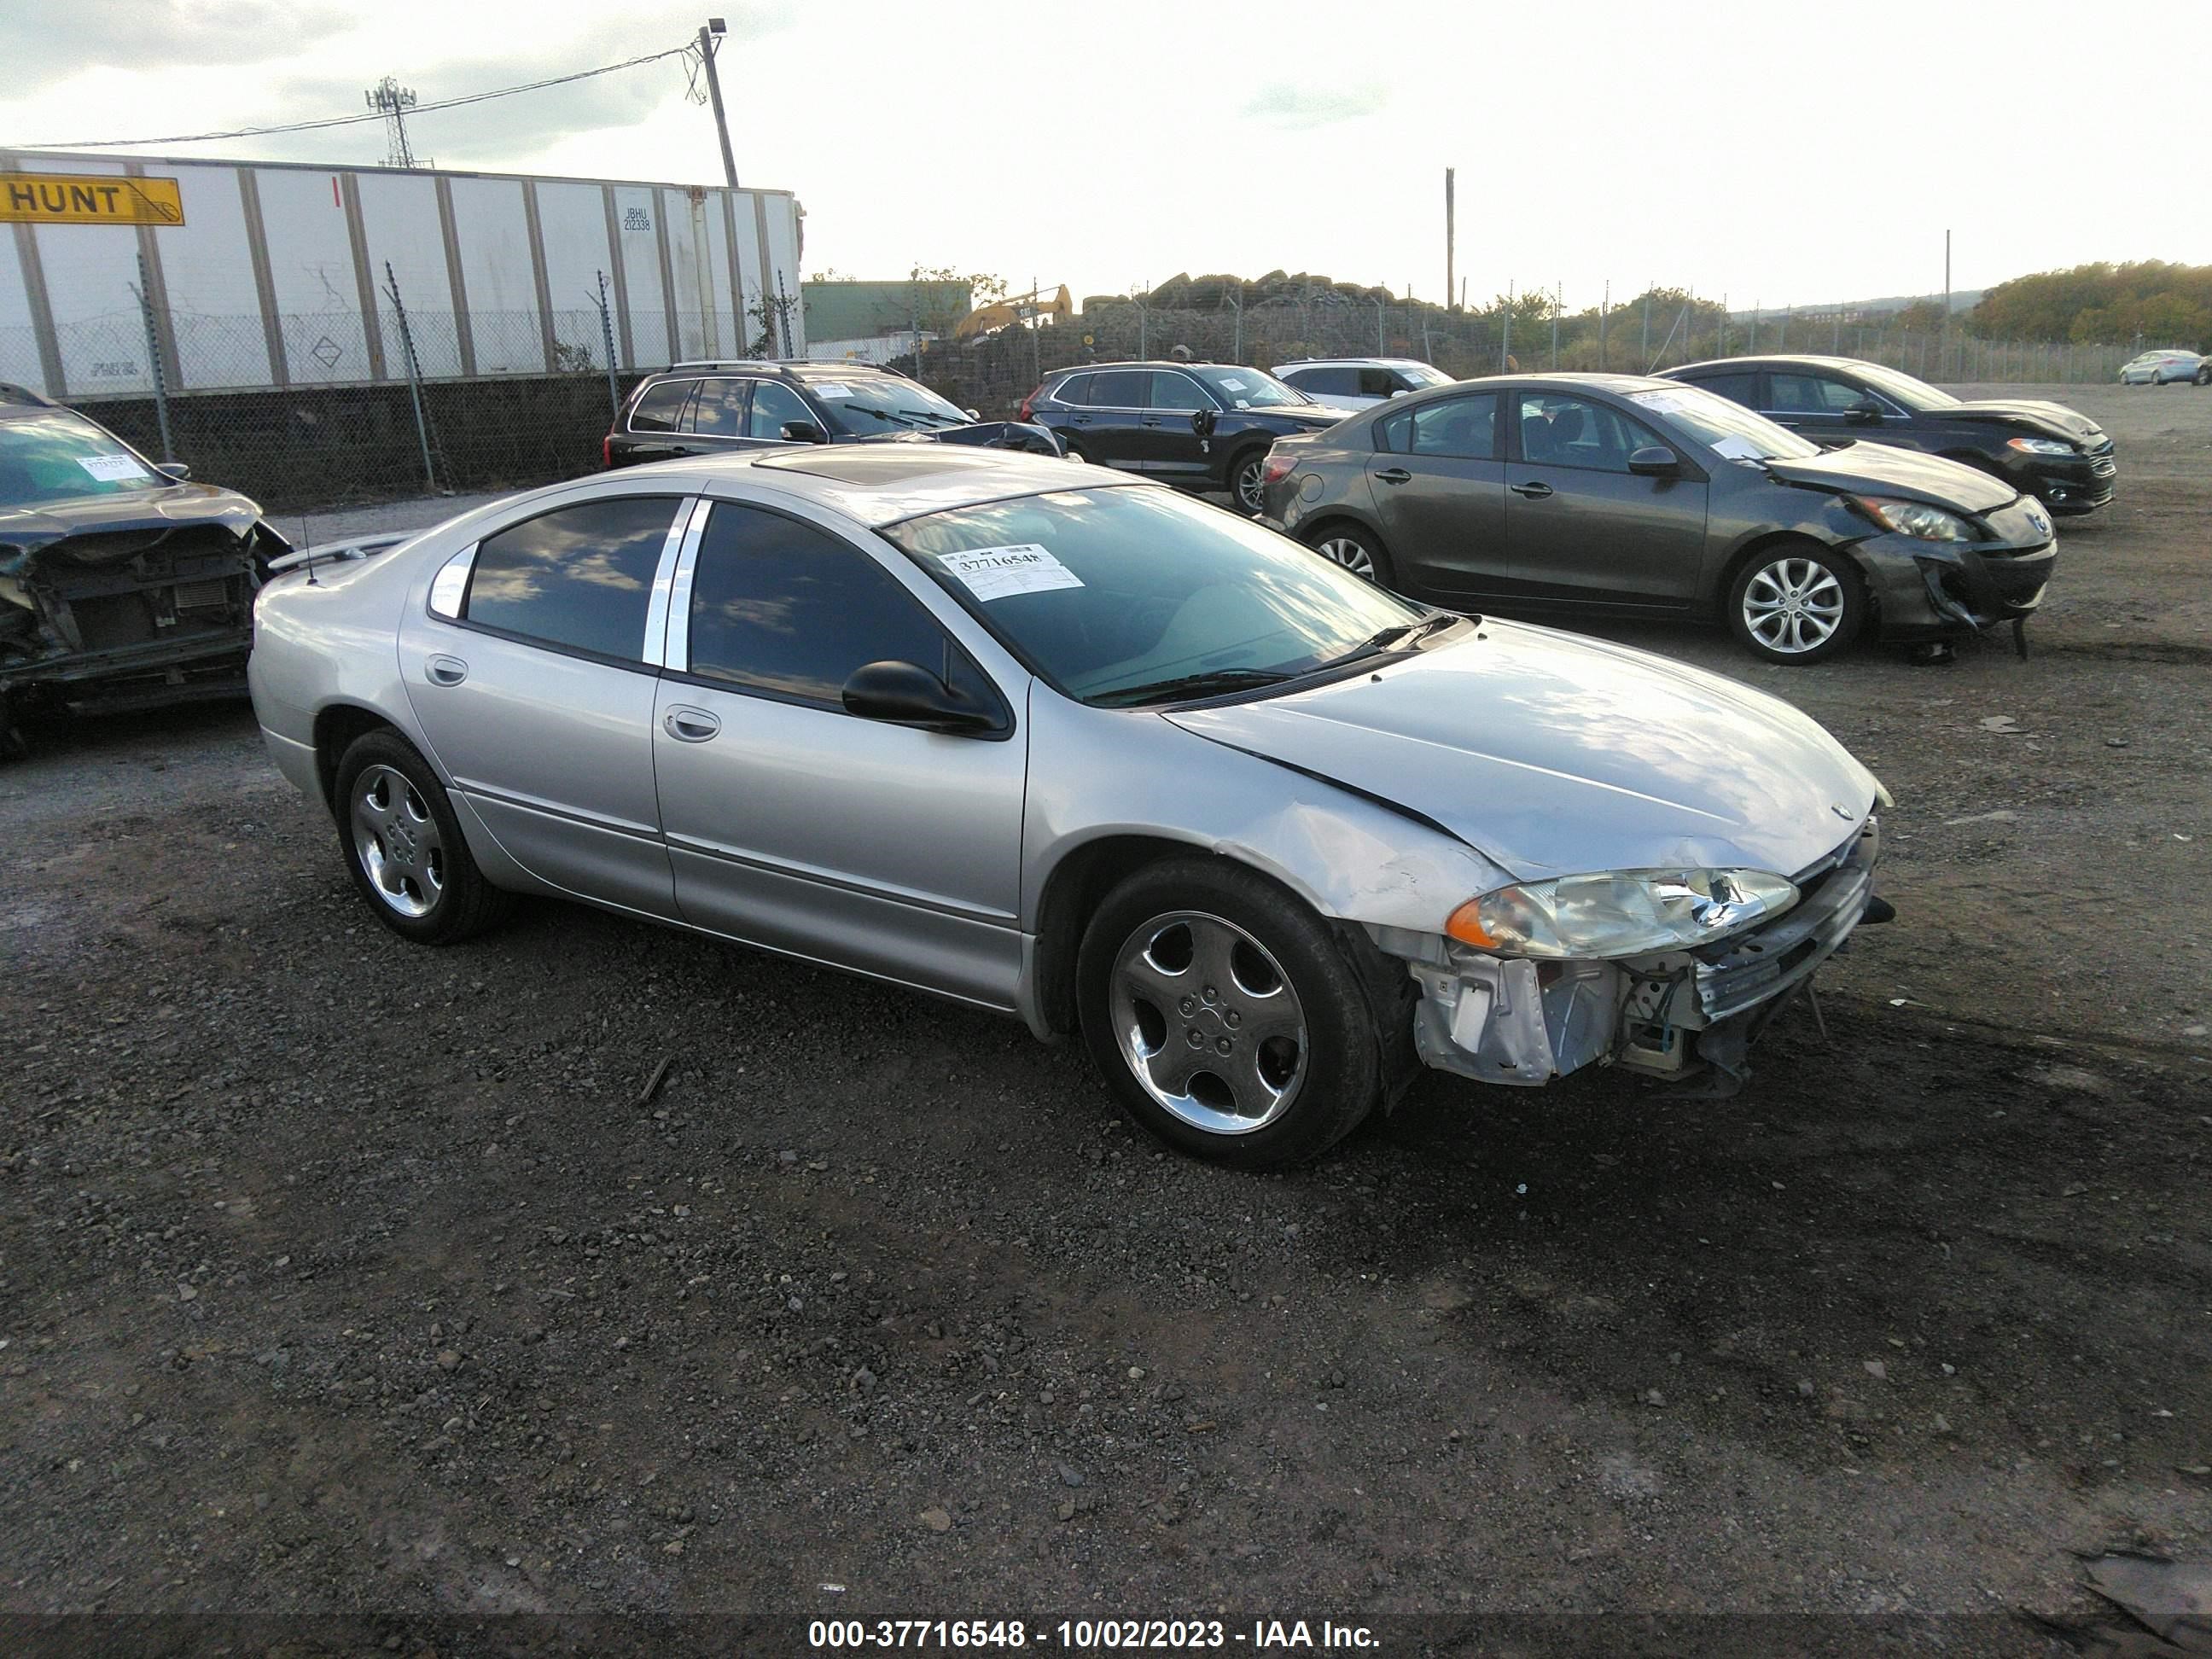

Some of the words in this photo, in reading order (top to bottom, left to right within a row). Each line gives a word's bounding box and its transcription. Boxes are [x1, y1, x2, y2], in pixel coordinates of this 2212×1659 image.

[8, 183, 120, 213] HUNT
[626, 207, 647, 219] JBHU
[623, 218, 650, 230] 212338
[958, 553, 1043, 573] 37716548
